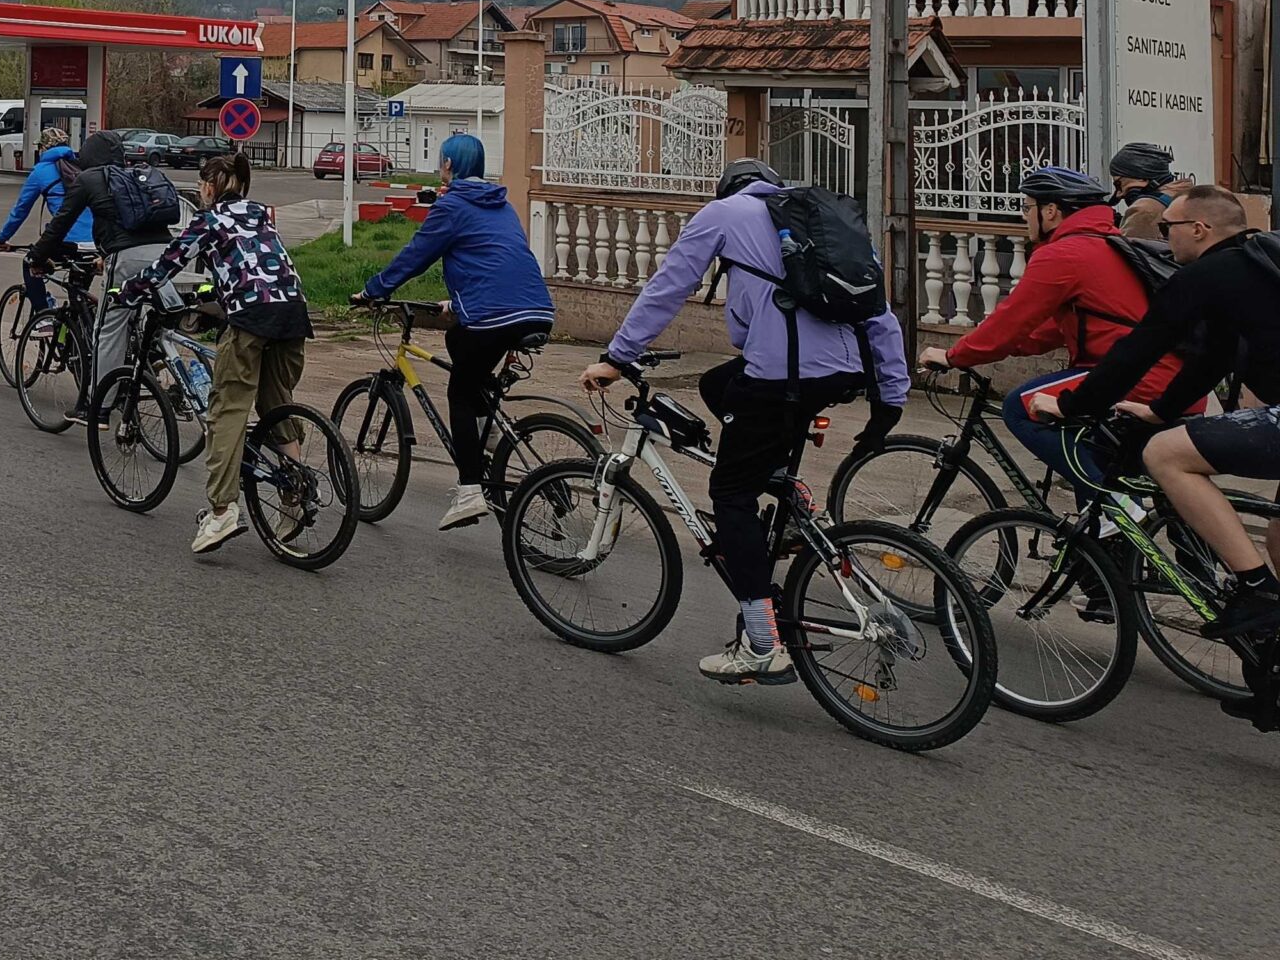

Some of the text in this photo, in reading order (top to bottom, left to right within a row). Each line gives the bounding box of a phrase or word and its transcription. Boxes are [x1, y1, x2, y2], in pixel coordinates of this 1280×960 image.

[199, 24, 255, 46] LUKOIL
[1127, 35, 1187, 60] SANITARIJA
[391, 102, 401, 115] P
[1128, 88, 1203, 113] KADE I KABINE
